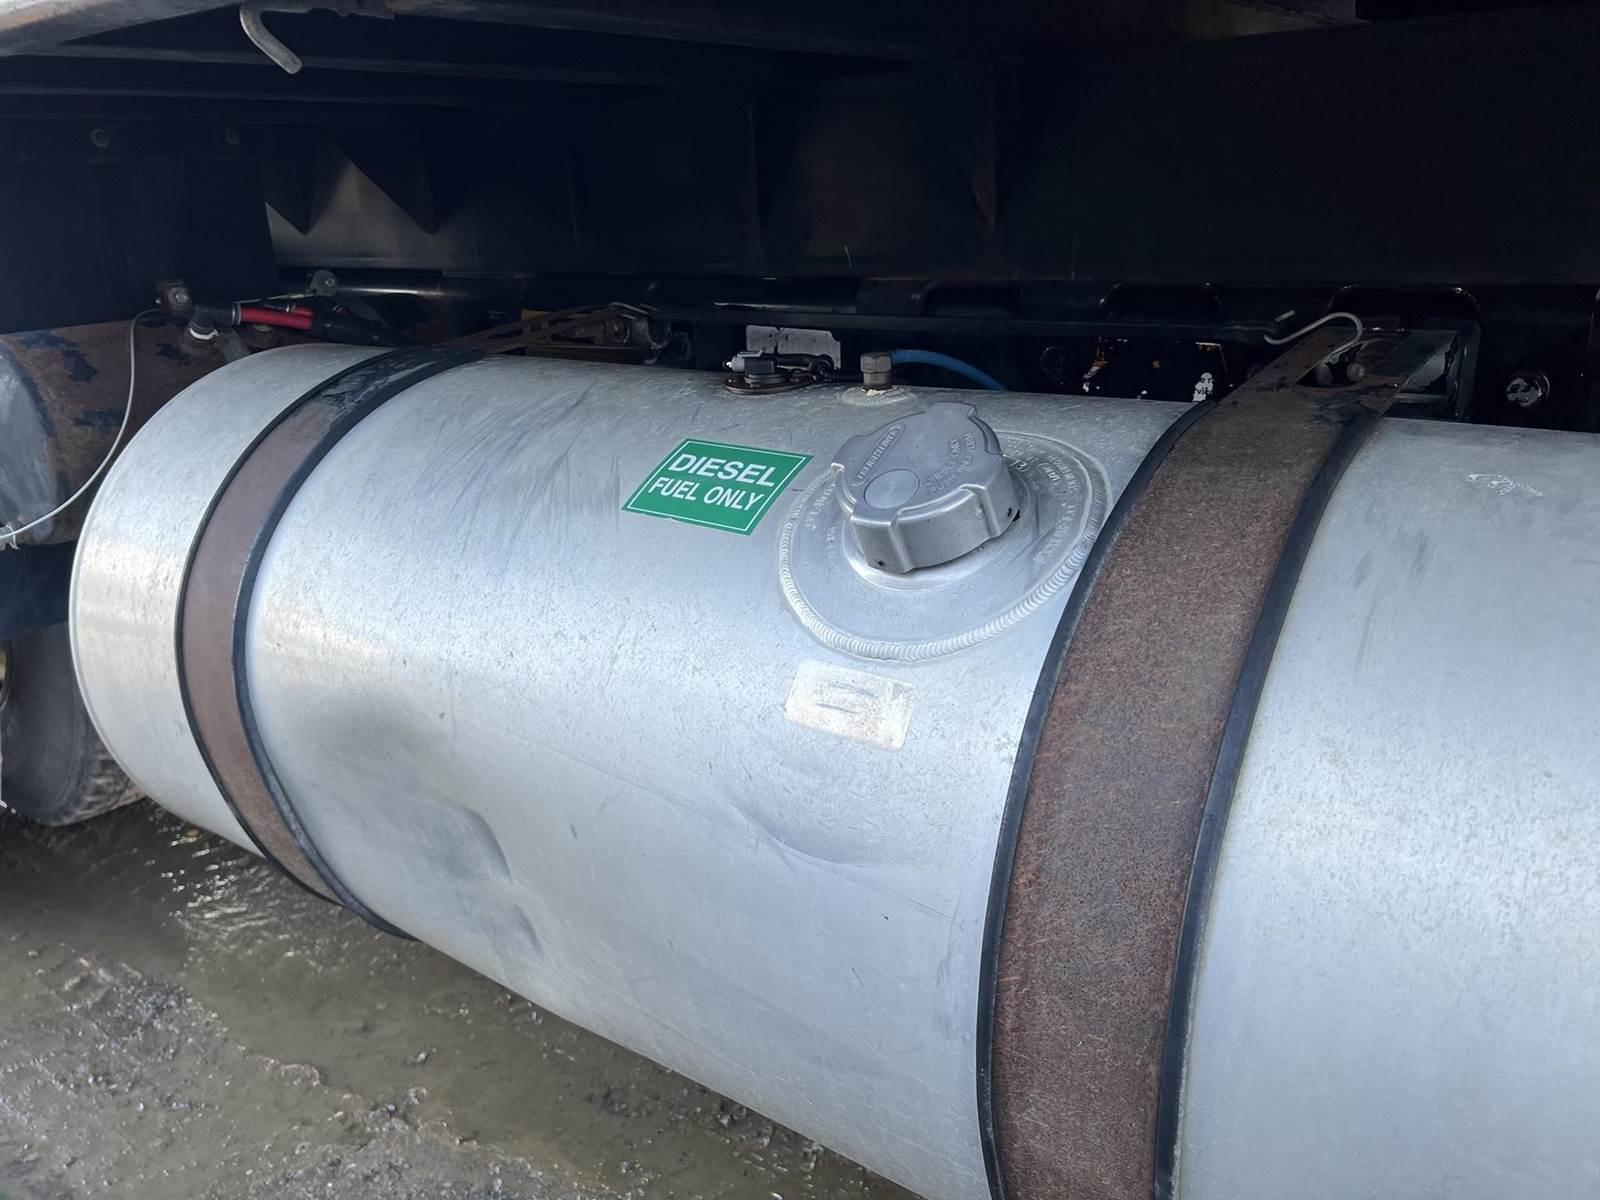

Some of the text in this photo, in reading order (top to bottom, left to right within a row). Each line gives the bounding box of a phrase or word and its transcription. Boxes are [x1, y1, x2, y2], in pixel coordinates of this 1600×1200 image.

[668, 453, 777, 487] DIESEL
[648, 477, 765, 511] FUEL ONLY
